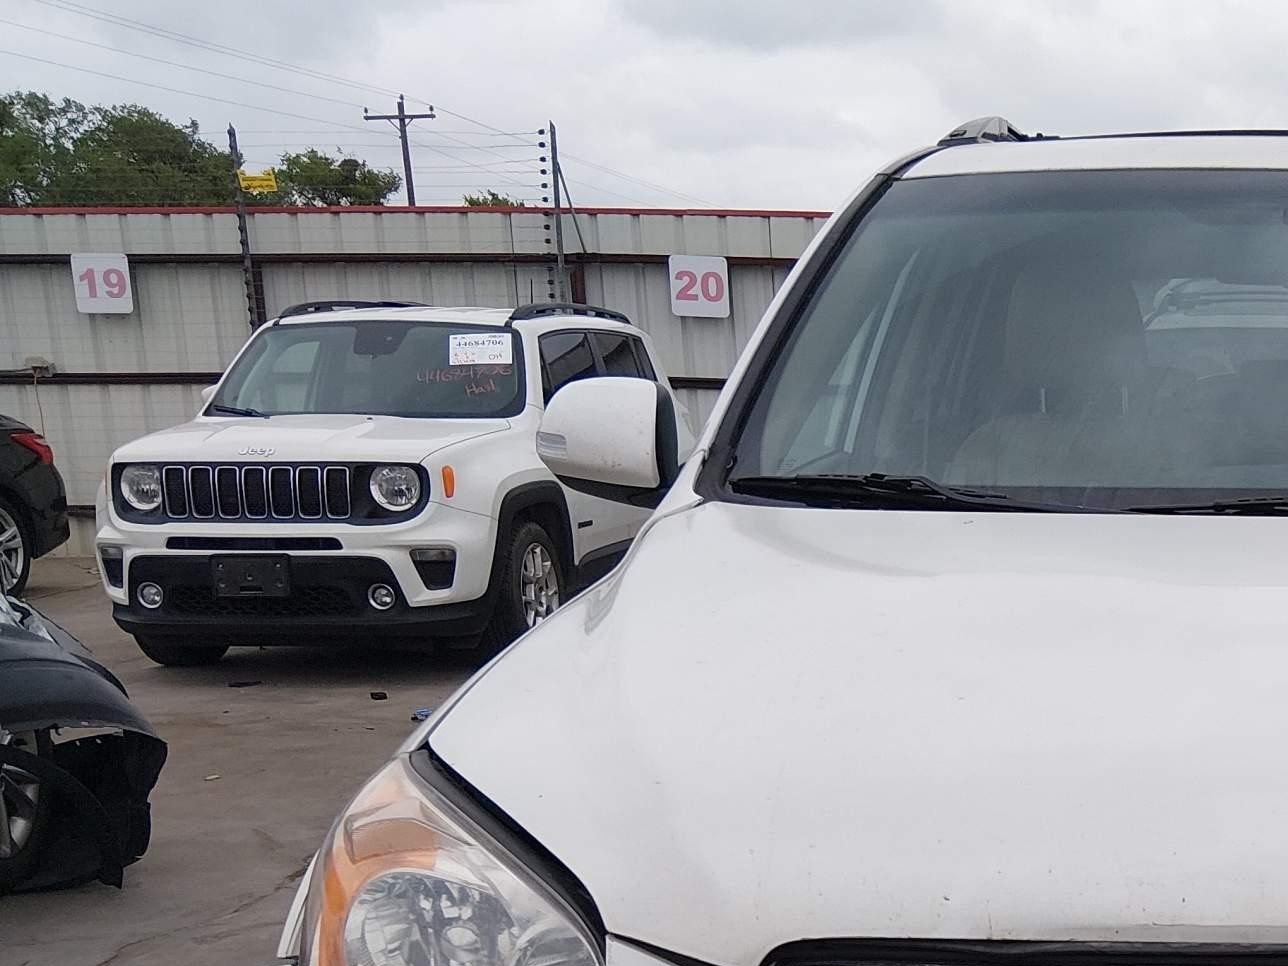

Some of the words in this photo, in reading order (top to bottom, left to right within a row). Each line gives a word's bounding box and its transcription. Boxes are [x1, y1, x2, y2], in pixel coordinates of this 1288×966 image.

[79, 268, 127, 299] 19
[674, 270, 725, 302] 20
[238, 446, 276, 458] Jeep
